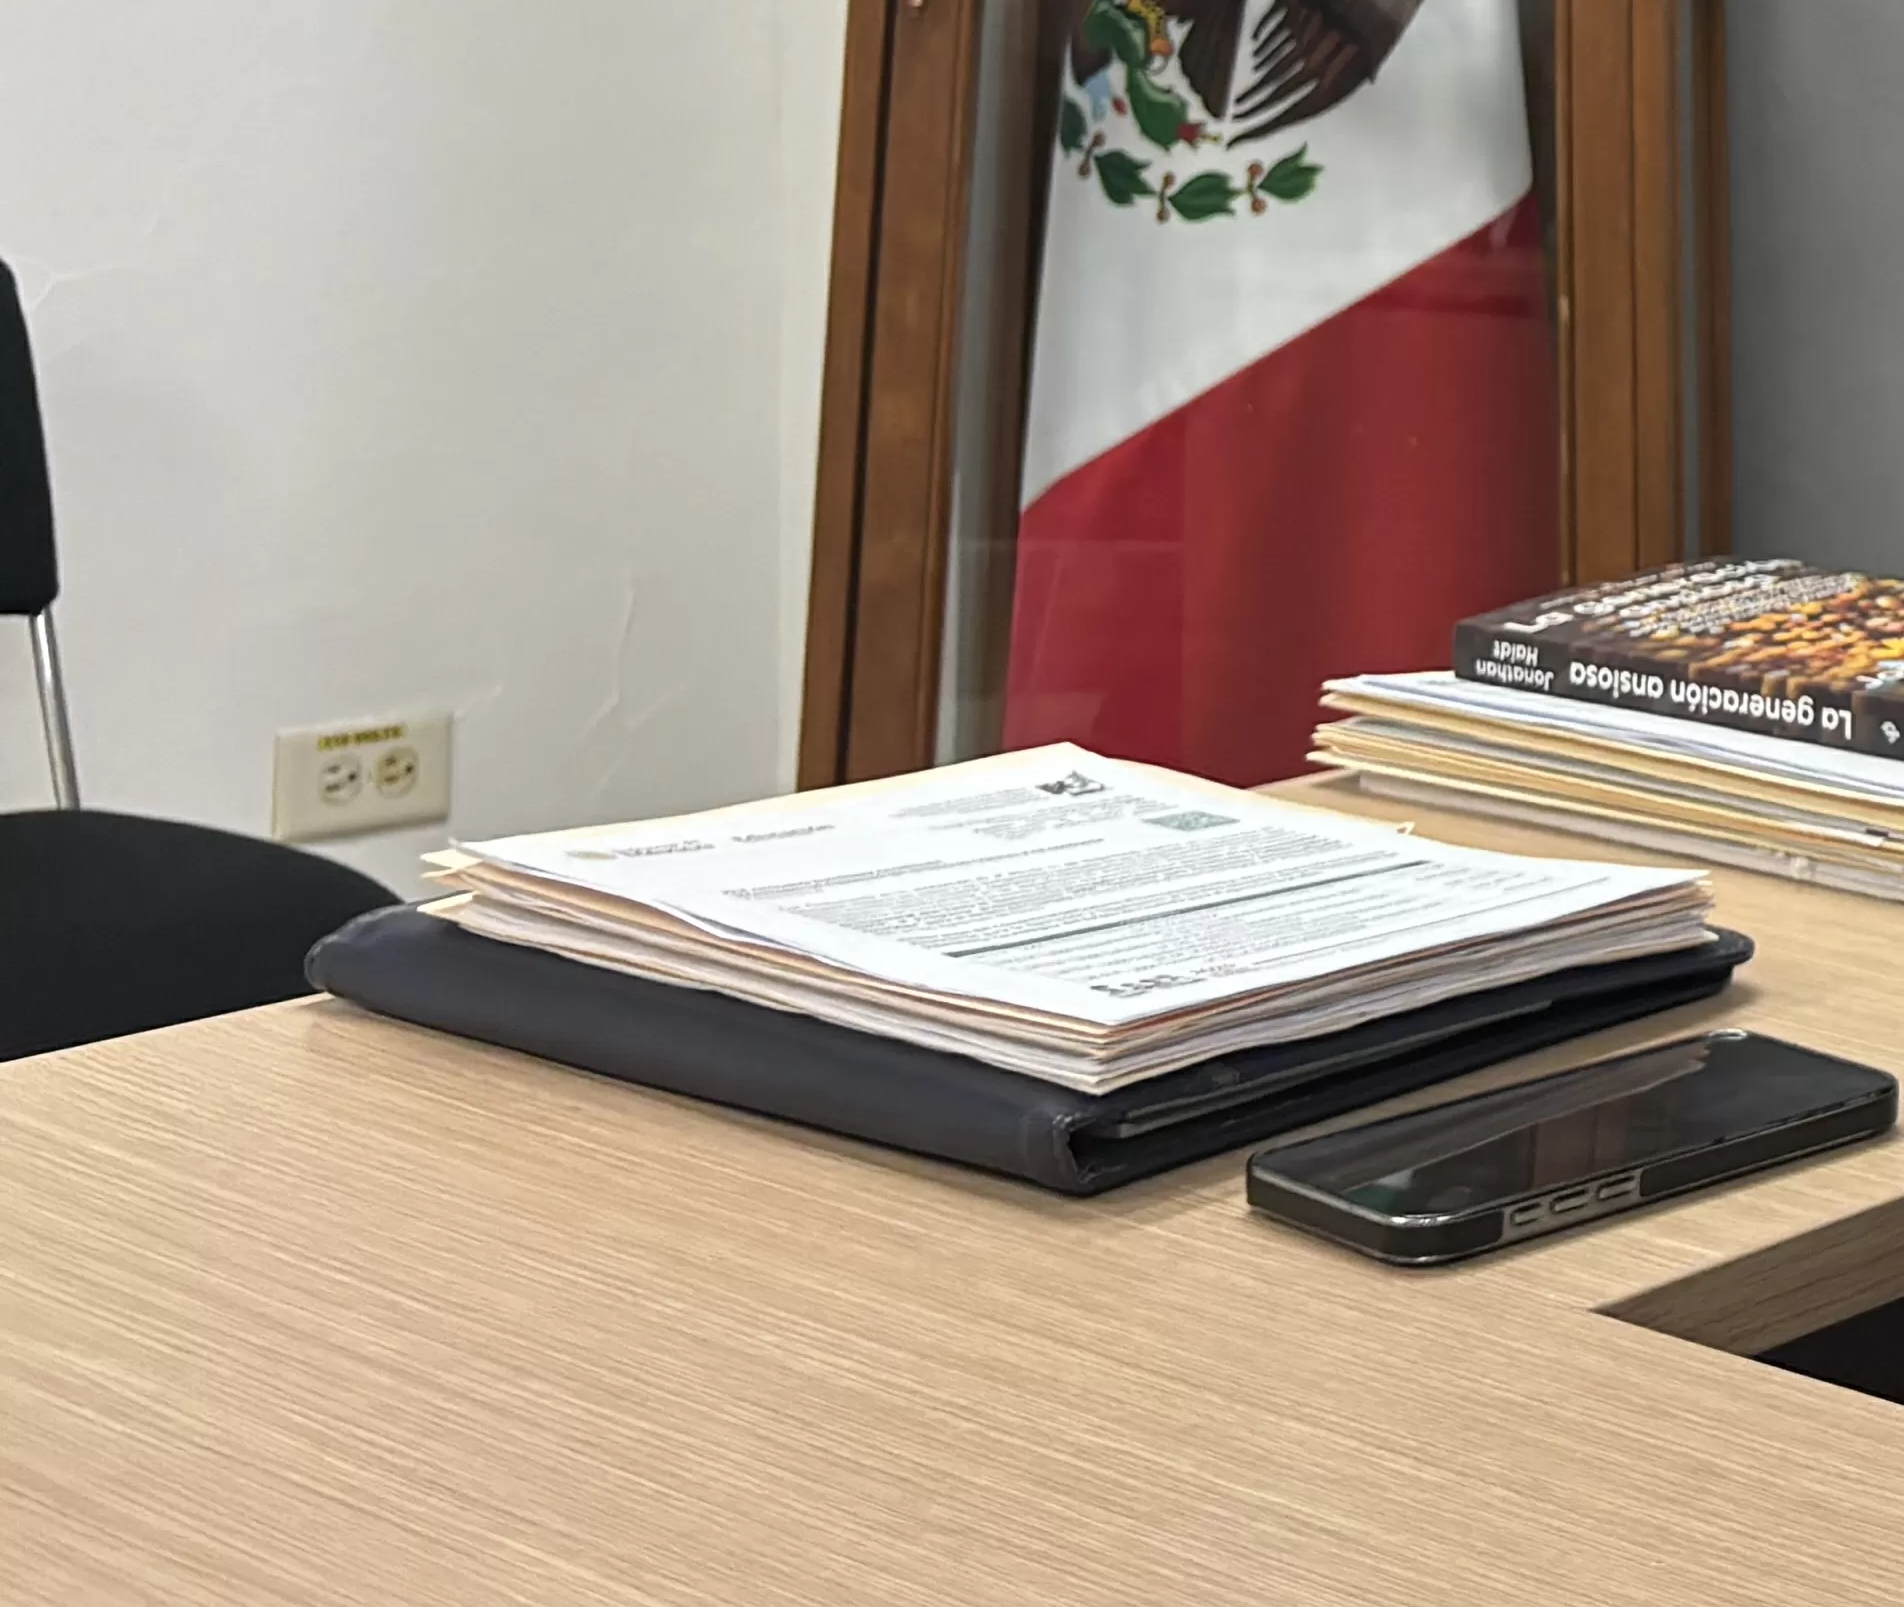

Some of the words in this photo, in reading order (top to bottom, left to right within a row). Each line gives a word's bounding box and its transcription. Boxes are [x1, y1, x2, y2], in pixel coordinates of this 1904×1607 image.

[1493, 639, 1539, 667] Haidt
[1474, 660, 1555, 692] Jonathan
[1569, 660, 1665, 700] ansiosa
[1670, 678, 1816, 727] generación
[1821, 708, 1853, 740] La
